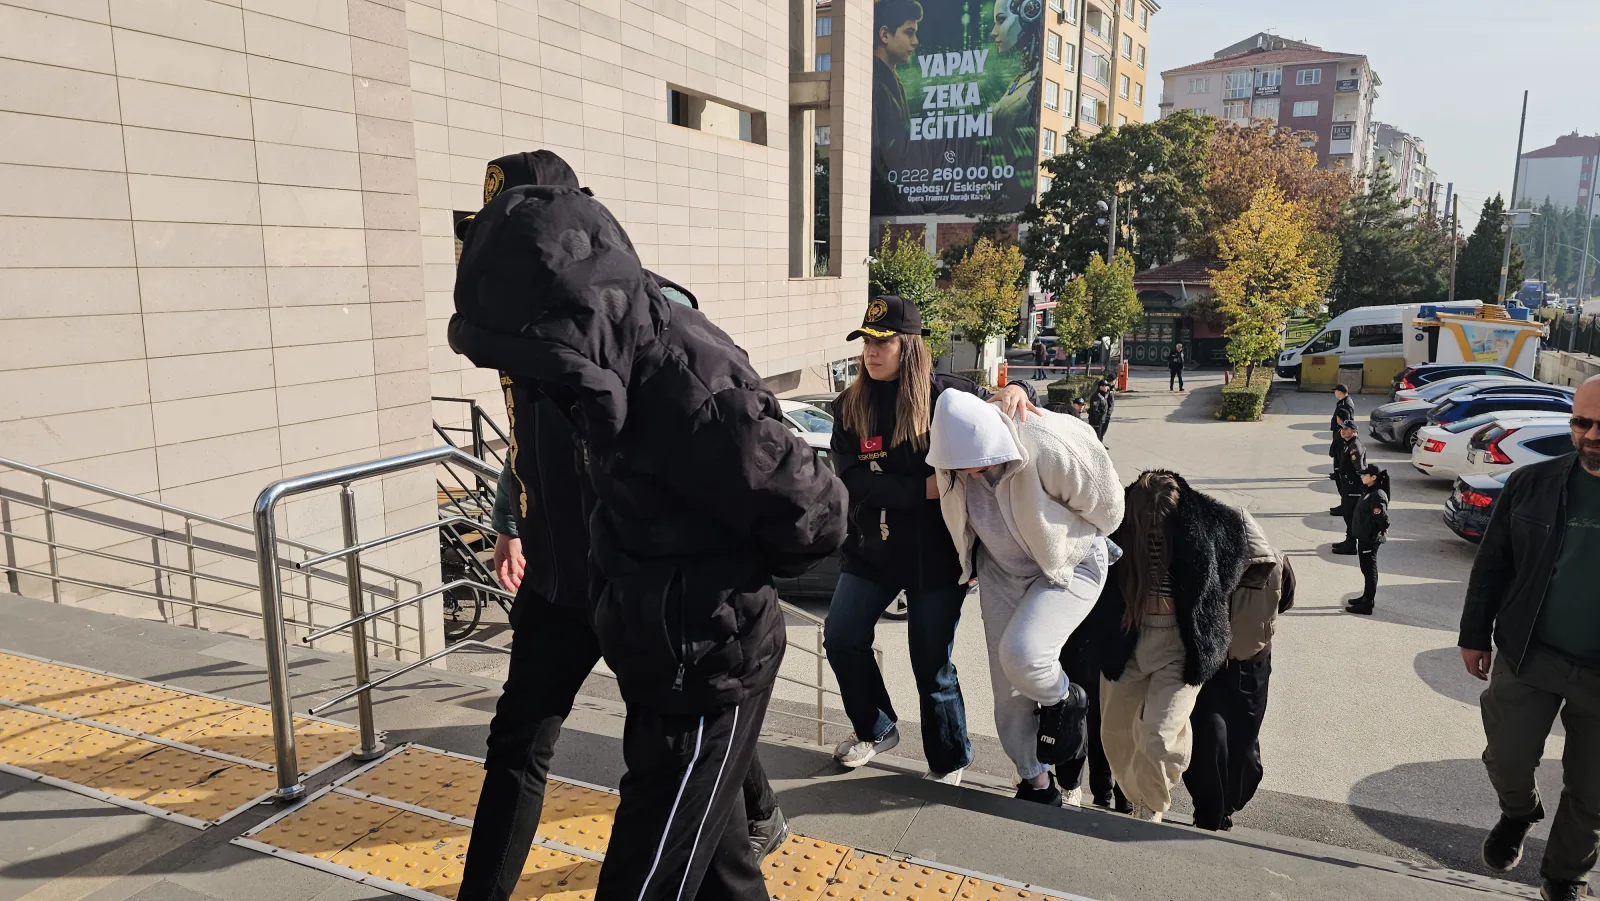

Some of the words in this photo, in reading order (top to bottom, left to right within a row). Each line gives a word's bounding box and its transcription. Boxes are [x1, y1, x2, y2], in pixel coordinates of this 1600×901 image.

[918, 49, 989, 78] YAPAY
[922, 82, 981, 109] ZEKA
[910, 107, 993, 141] EĞİTİMİ
[888, 170, 897, 182] 0
[901, 169, 929, 182] 222
[932, 167, 963, 181] 260
[966, 166, 988, 180] 00
[992, 165, 1014, 179] 00
[897, 183, 943, 195] Tepebaşı
[925, 194, 949, 202] Tramvay
[858, 451, 888, 460] ESKİŞEHİR
